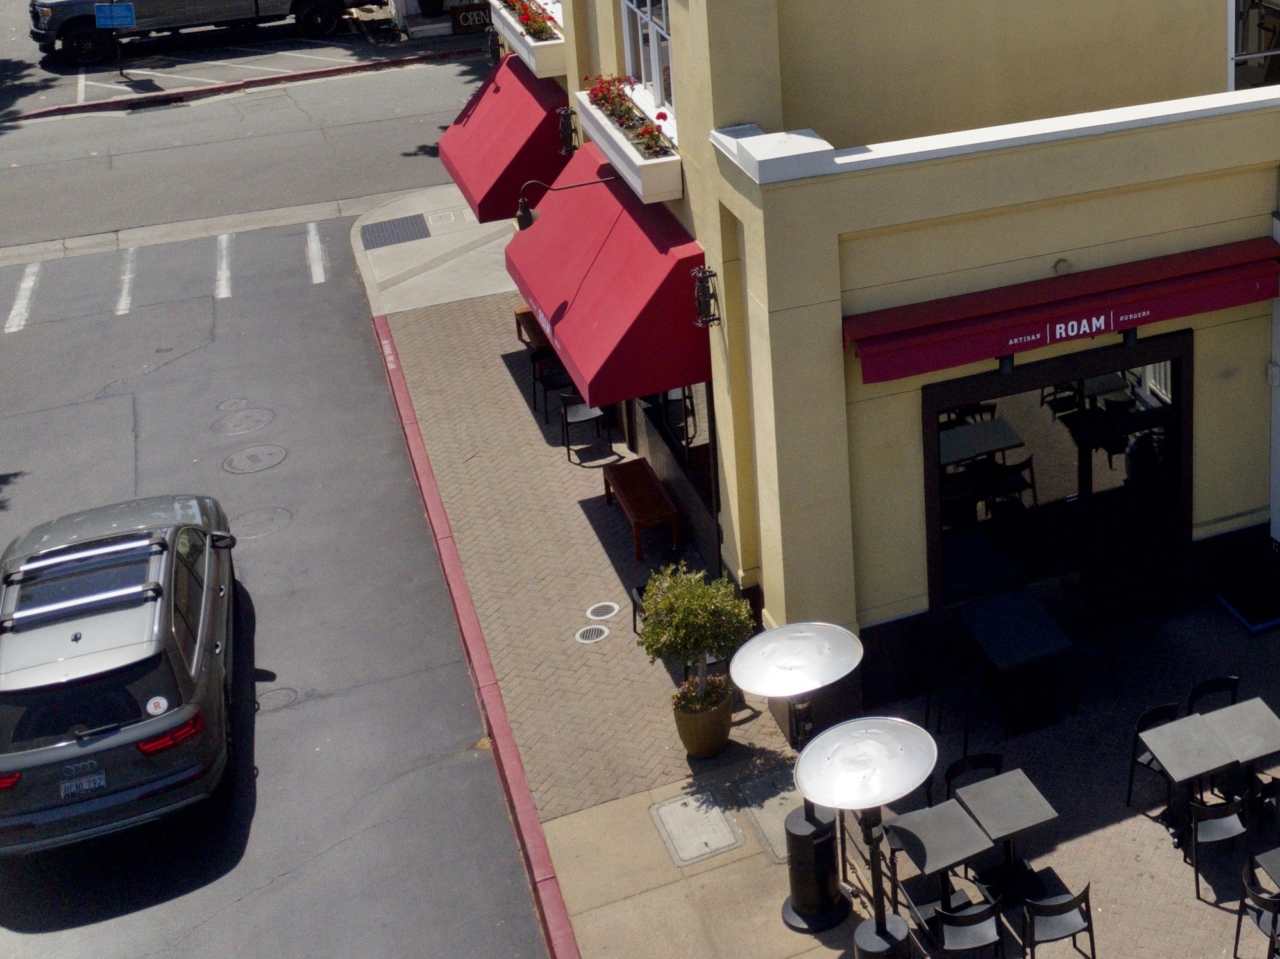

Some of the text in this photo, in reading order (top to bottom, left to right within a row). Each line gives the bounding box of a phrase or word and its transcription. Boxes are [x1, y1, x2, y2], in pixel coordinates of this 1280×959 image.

[460, 11, 490, 25] OPEN
[1008, 310, 1151, 345] ARTISAN ROAM BURGERS
